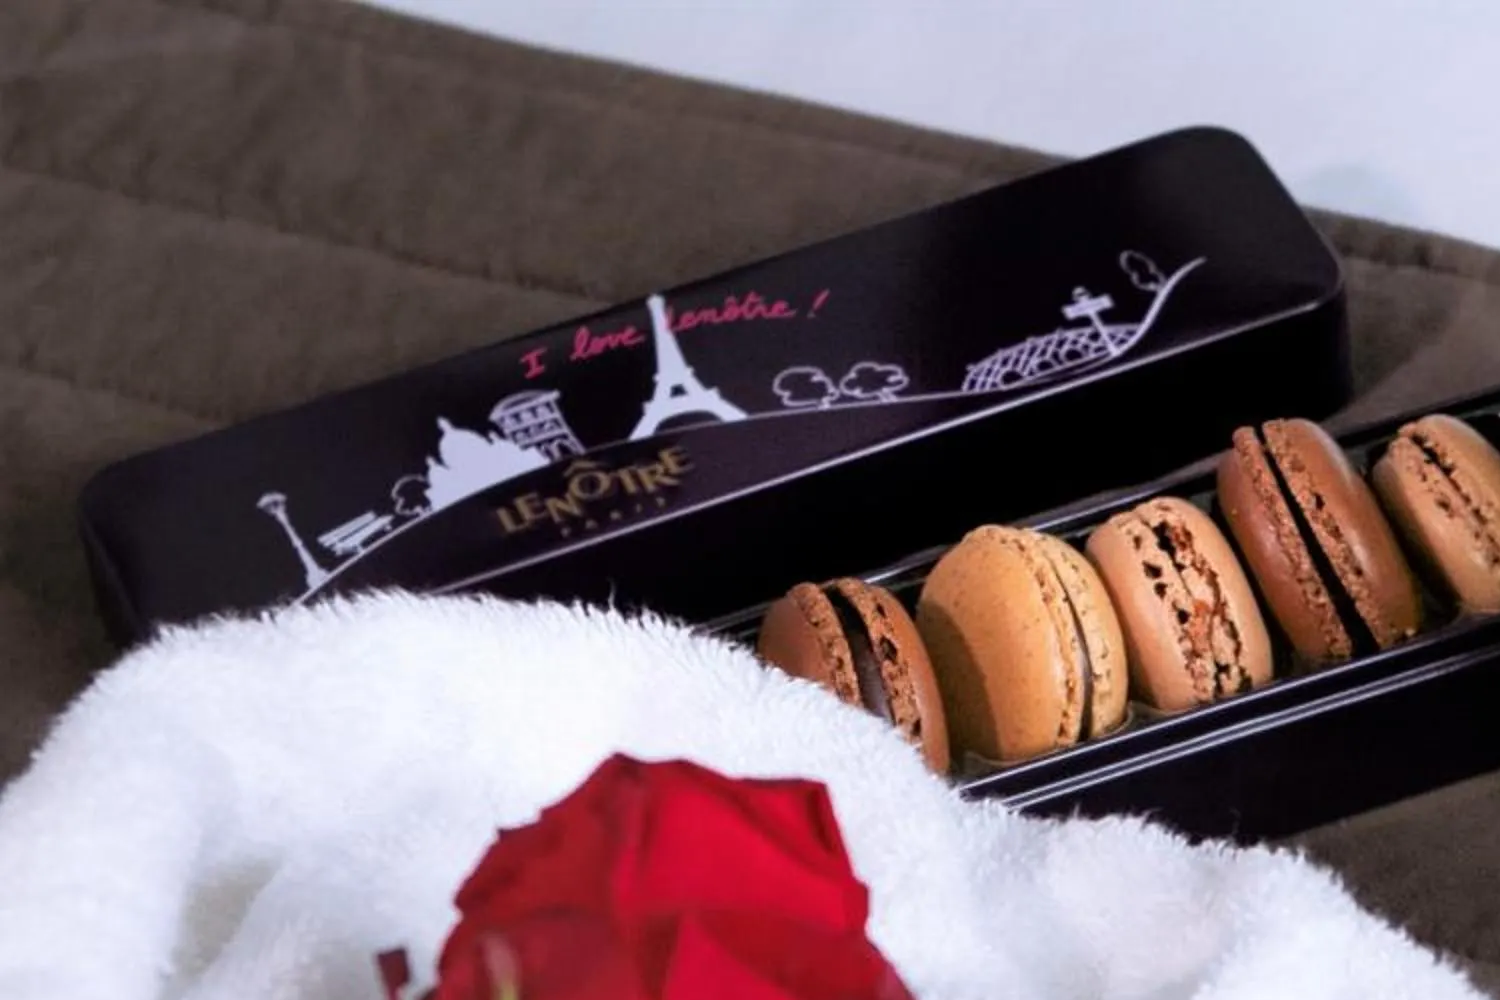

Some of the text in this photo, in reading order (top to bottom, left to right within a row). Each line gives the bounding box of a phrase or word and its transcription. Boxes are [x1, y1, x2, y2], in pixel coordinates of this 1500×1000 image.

[520, 348, 546, 379] I
[569, 325, 645, 361] love
[496, 446, 695, 534] LENÔTRE
